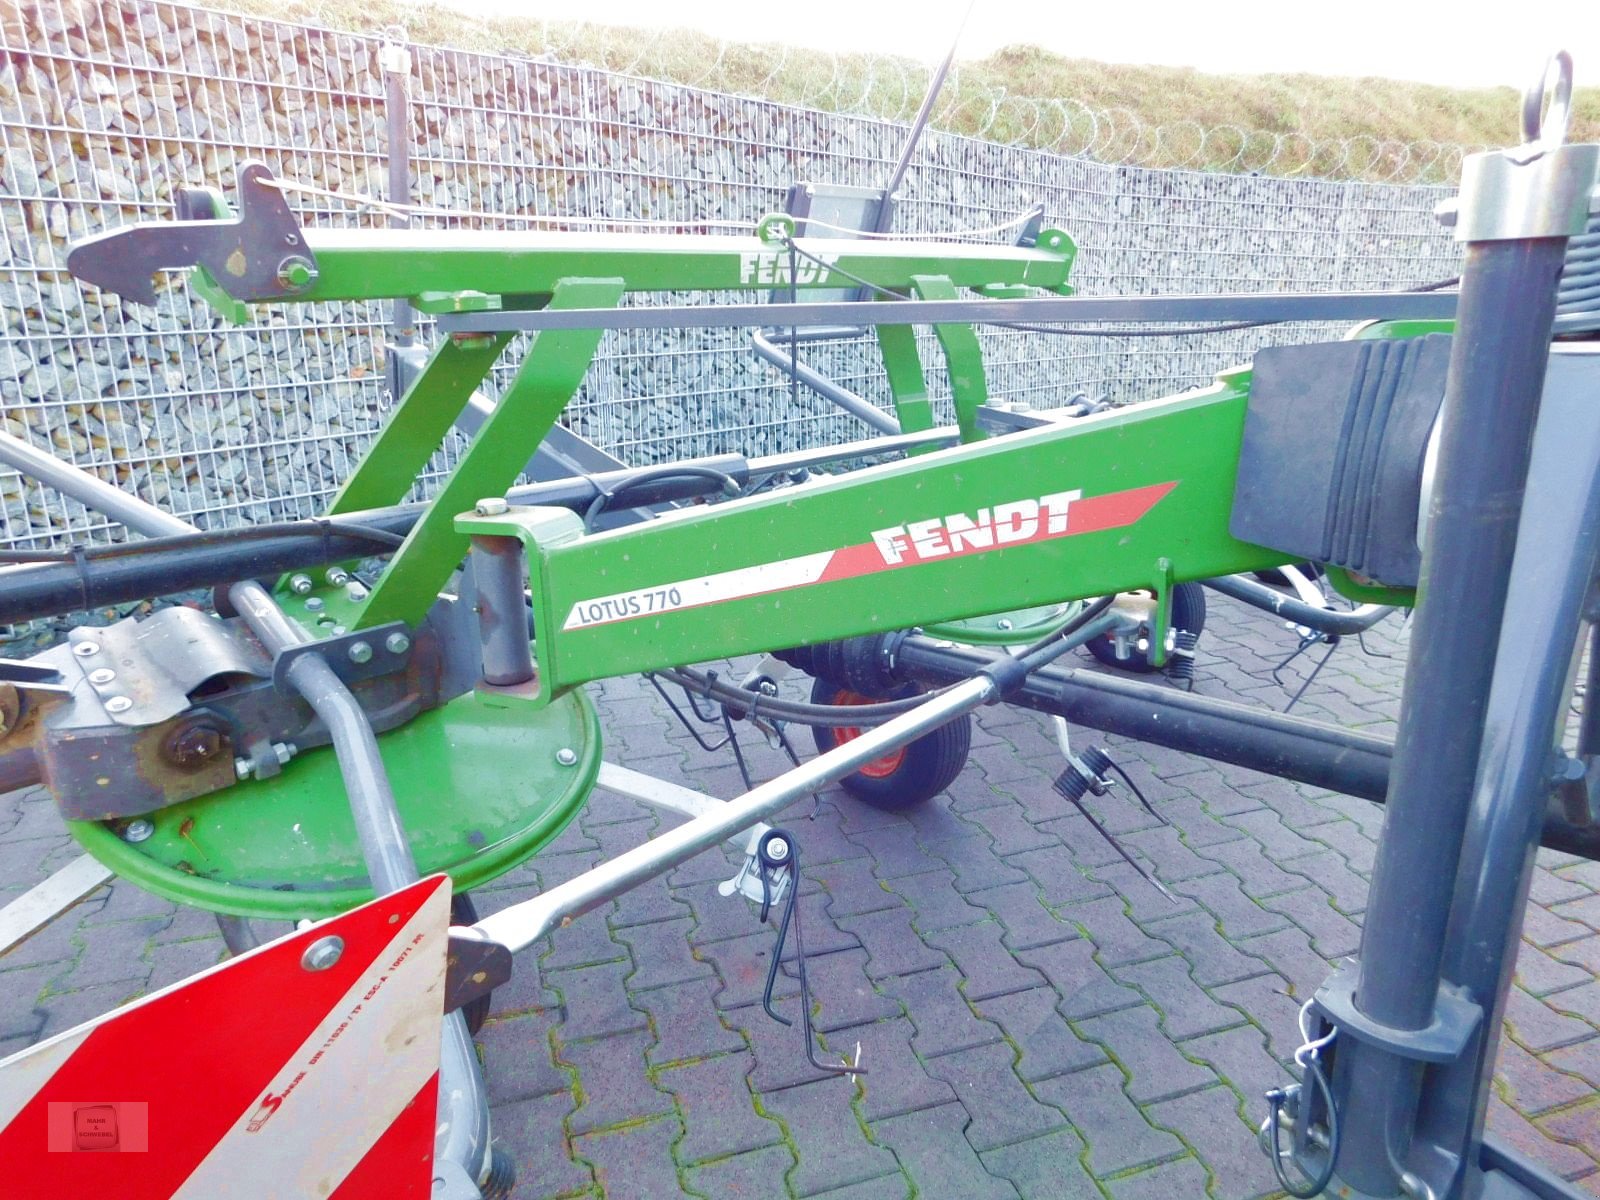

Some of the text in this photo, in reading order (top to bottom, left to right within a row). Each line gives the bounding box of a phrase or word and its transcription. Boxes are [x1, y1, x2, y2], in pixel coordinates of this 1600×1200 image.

[740, 253, 840, 284] FENDT
[870, 488, 1082, 565] FENDT
[578, 586, 682, 624] LOTUS 770
[308, 1050, 325, 1065] DIN
